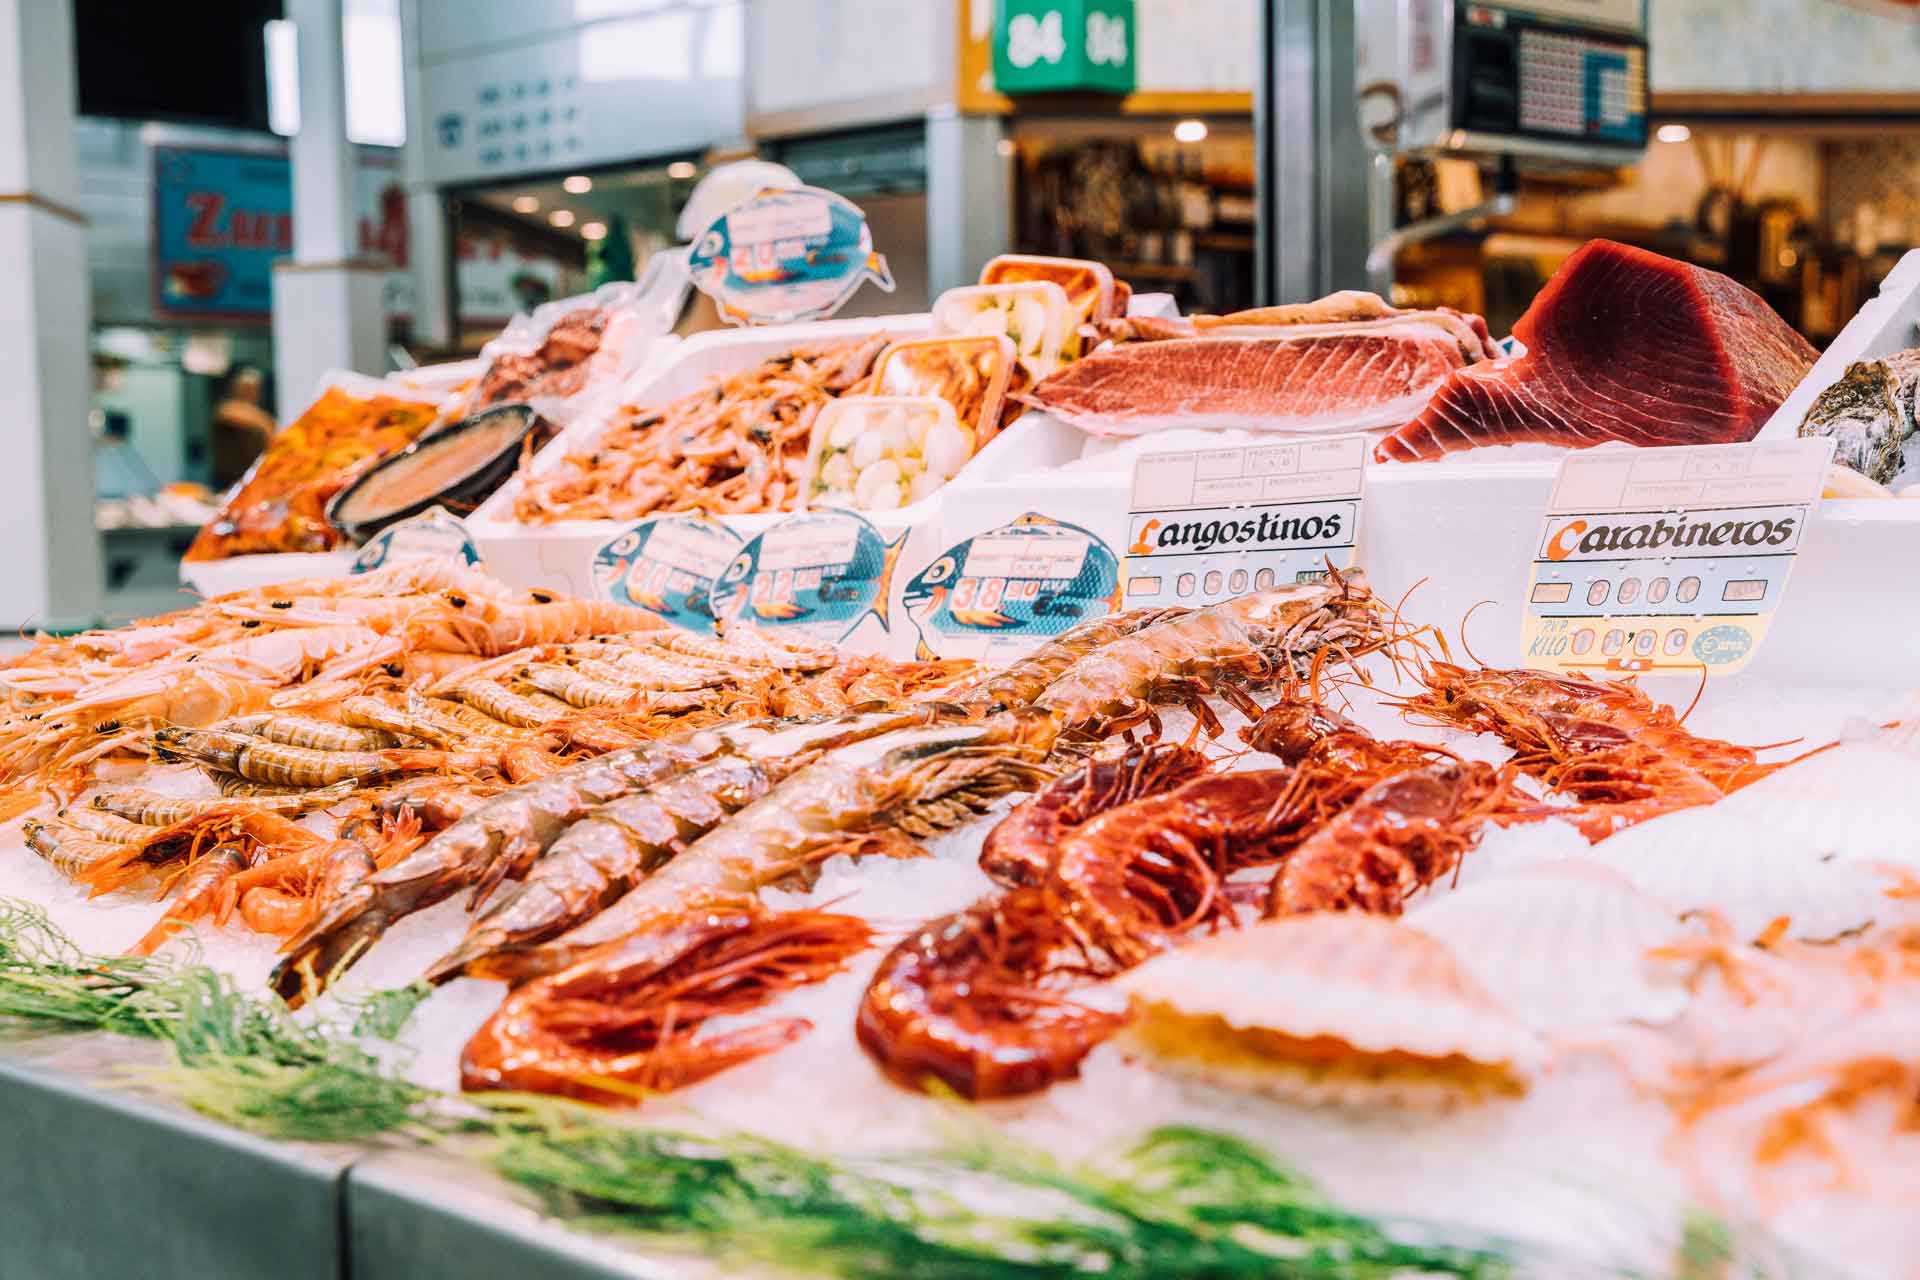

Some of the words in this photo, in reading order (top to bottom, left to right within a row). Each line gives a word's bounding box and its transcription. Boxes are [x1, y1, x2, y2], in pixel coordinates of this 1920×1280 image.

[1007, 9, 1066, 69] 84
[1128, 513, 1342, 556] Langostinos
[1546, 516, 1796, 561] Carabineros
[1528, 635, 1568, 656] KILO
